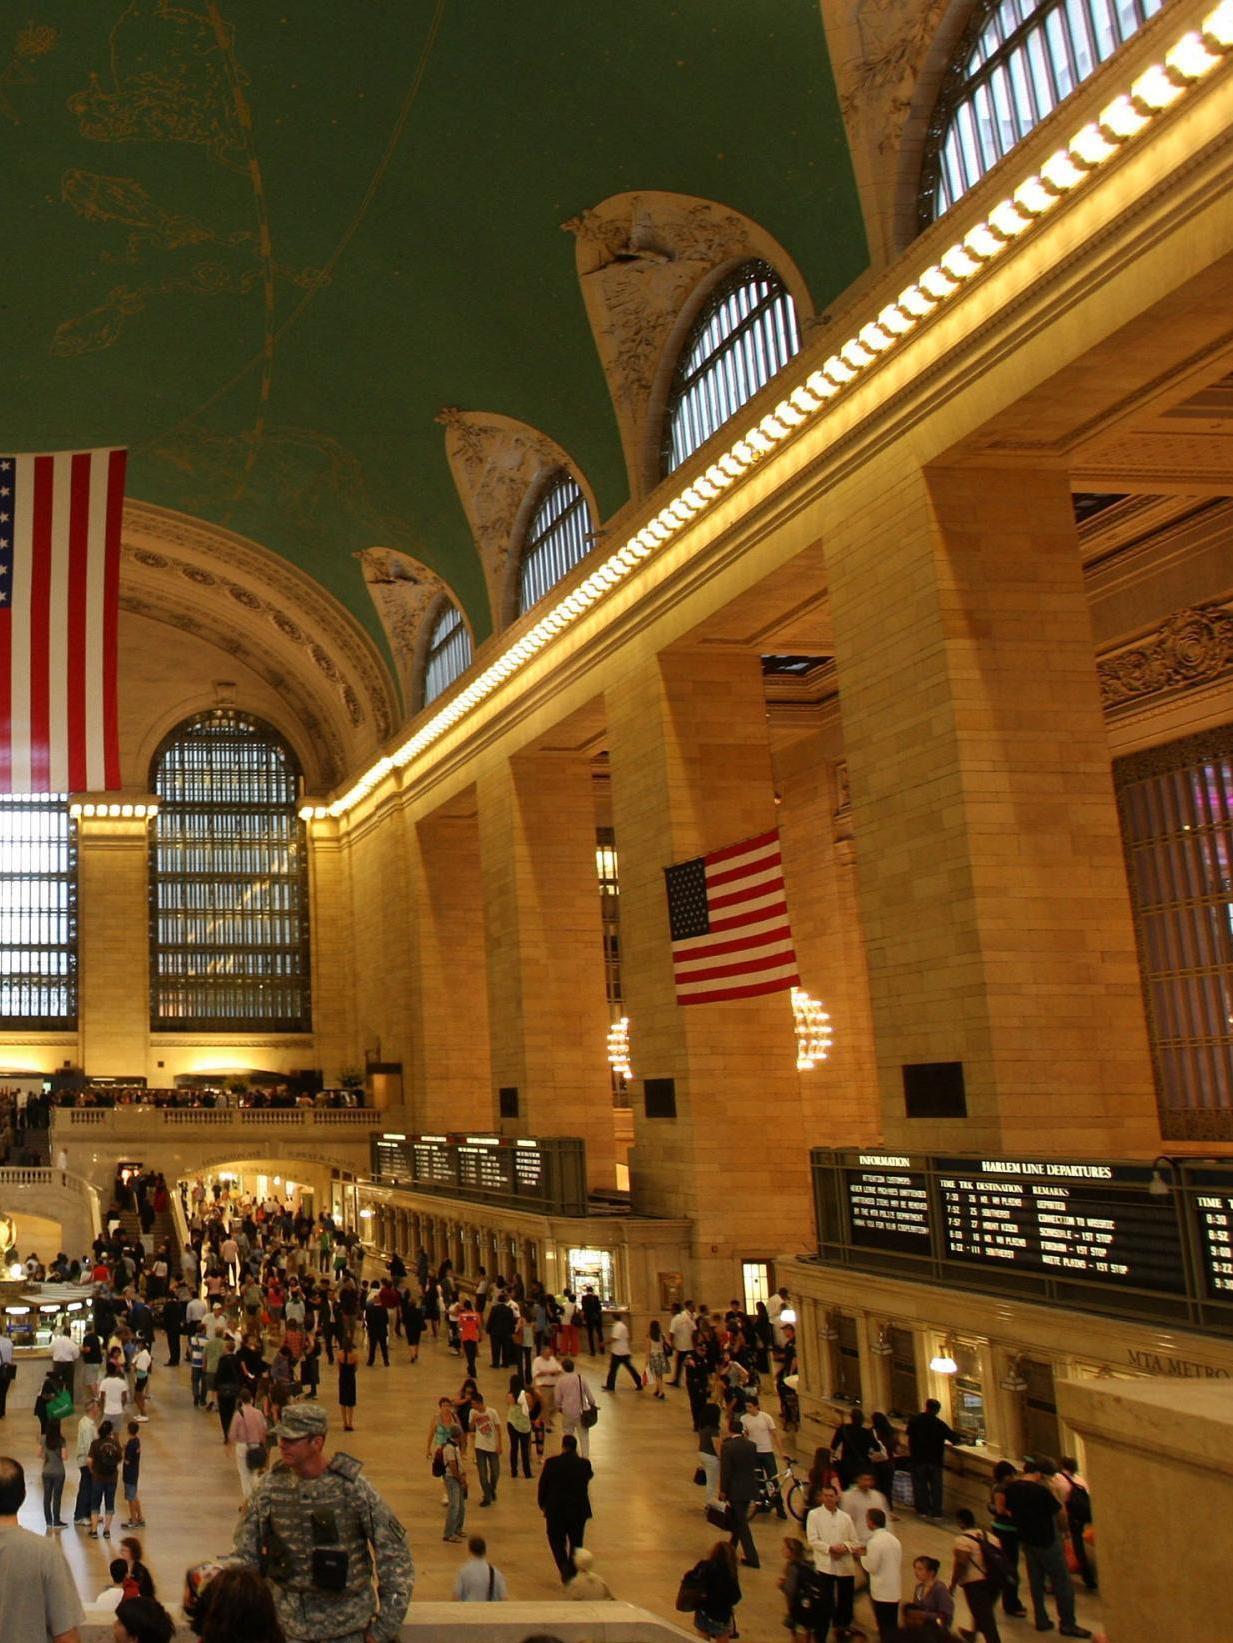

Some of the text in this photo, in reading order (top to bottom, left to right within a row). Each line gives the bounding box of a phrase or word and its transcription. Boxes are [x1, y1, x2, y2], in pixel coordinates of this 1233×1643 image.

[859, 1156, 910, 1167] INFORMATION
[982, 1161, 1112, 1178] HARLEM LINE DEPARTURES
[940, 1180, 1070, 1196] TIME TRK DESTINATION REMARKS
[1197, 1197, 1223, 1209] TIME
[1128, 1349, 1231, 1379] MTA METRO
